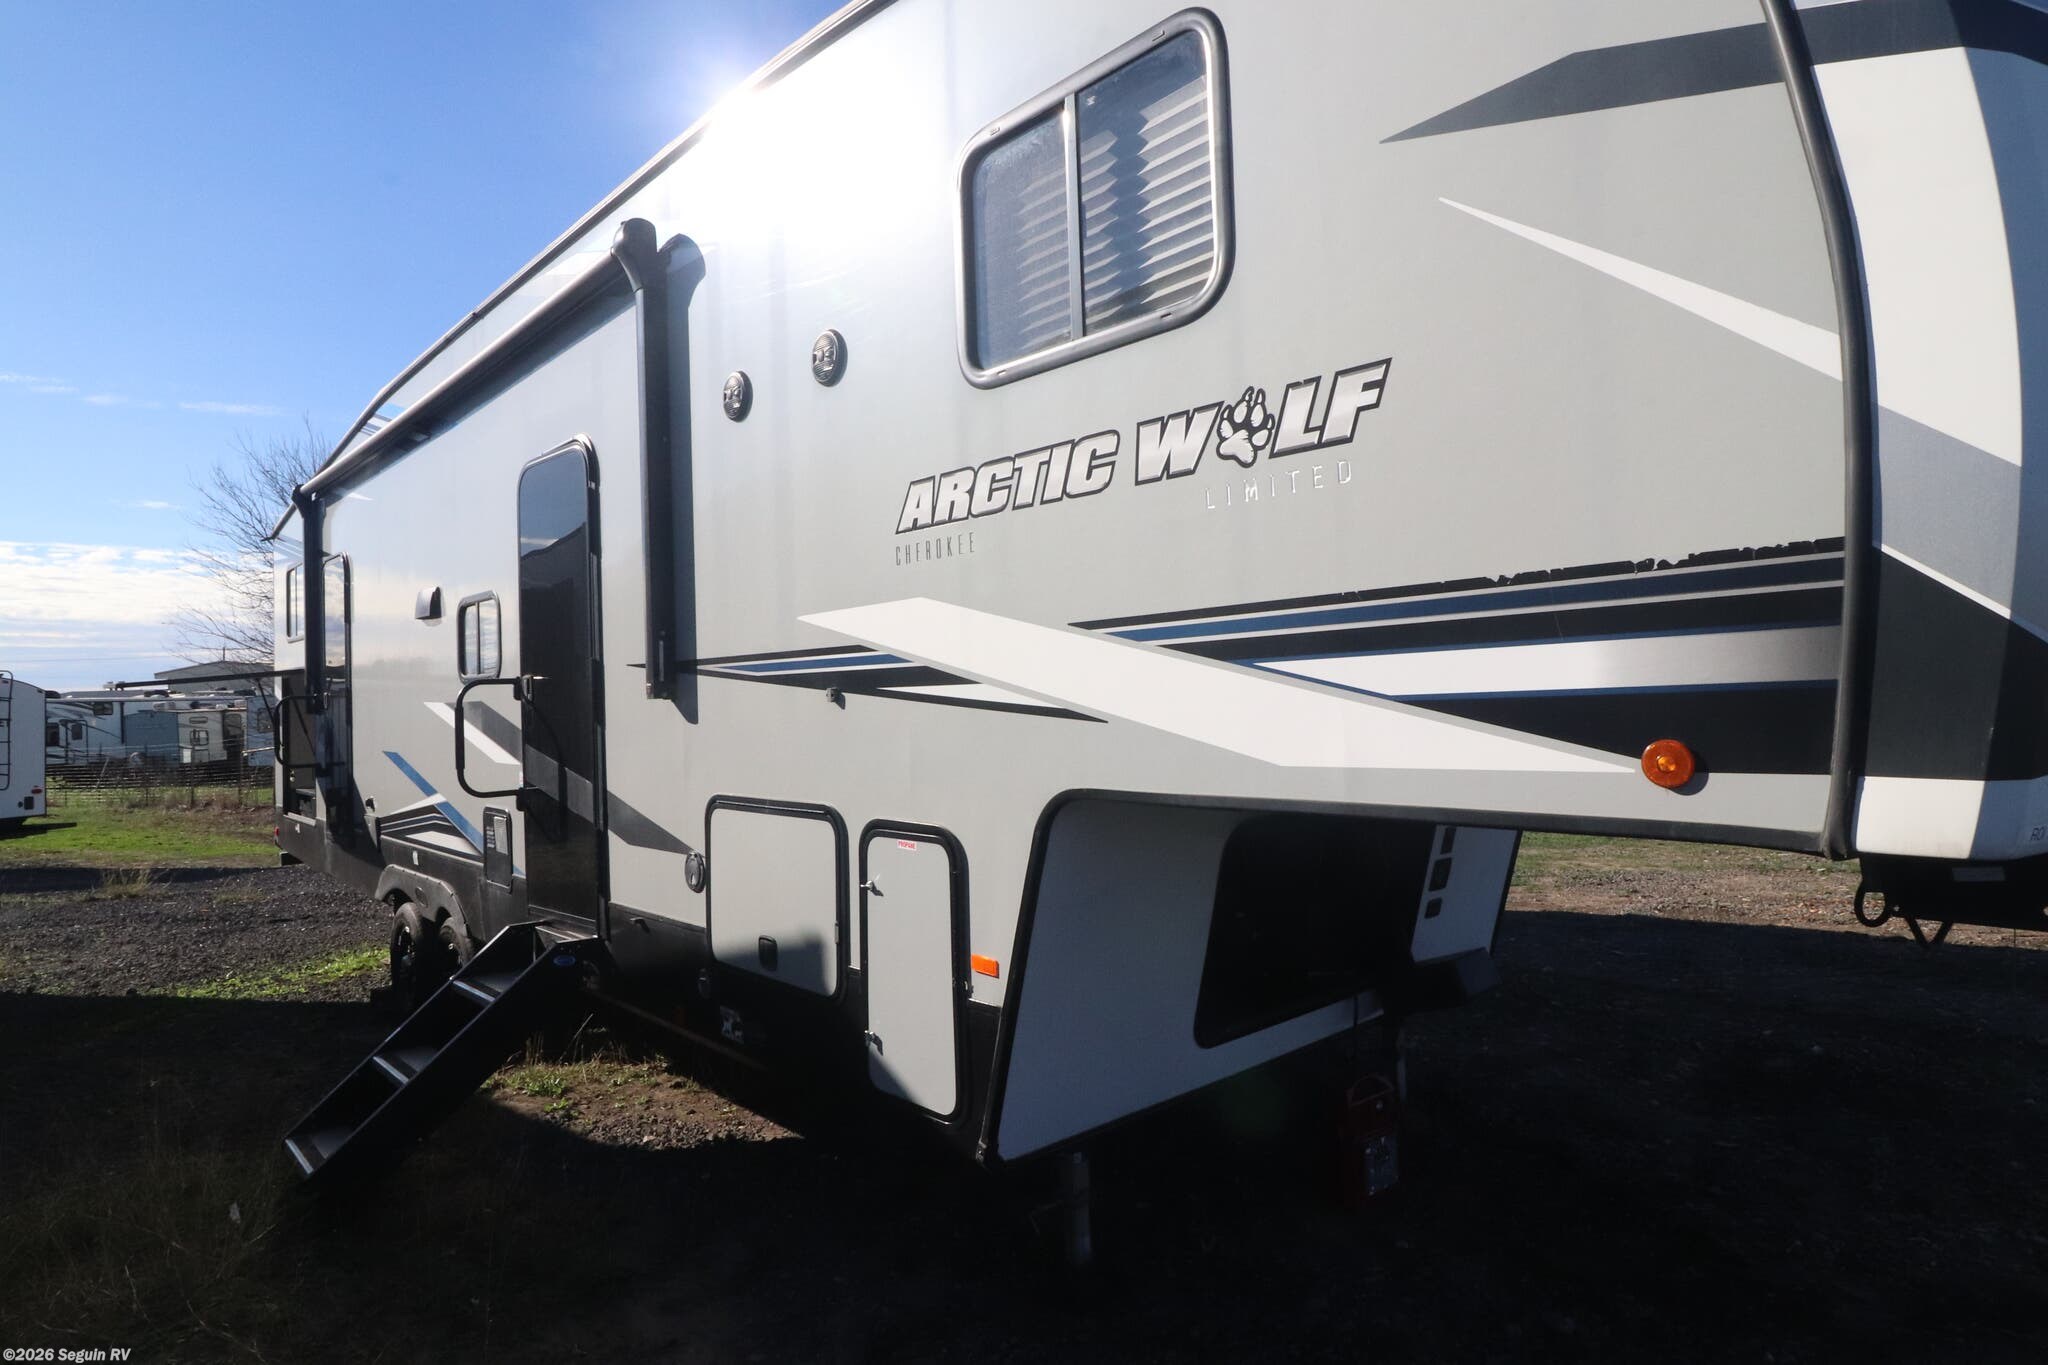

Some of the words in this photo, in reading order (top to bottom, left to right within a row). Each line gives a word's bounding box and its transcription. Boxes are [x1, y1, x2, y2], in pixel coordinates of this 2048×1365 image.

[896, 430, 1121, 534] ARCTIC
[1135, 358, 1392, 486] WLF
[1206, 460, 1352, 509] LIMITED
[895, 532, 975, 566] CHEROKEE
